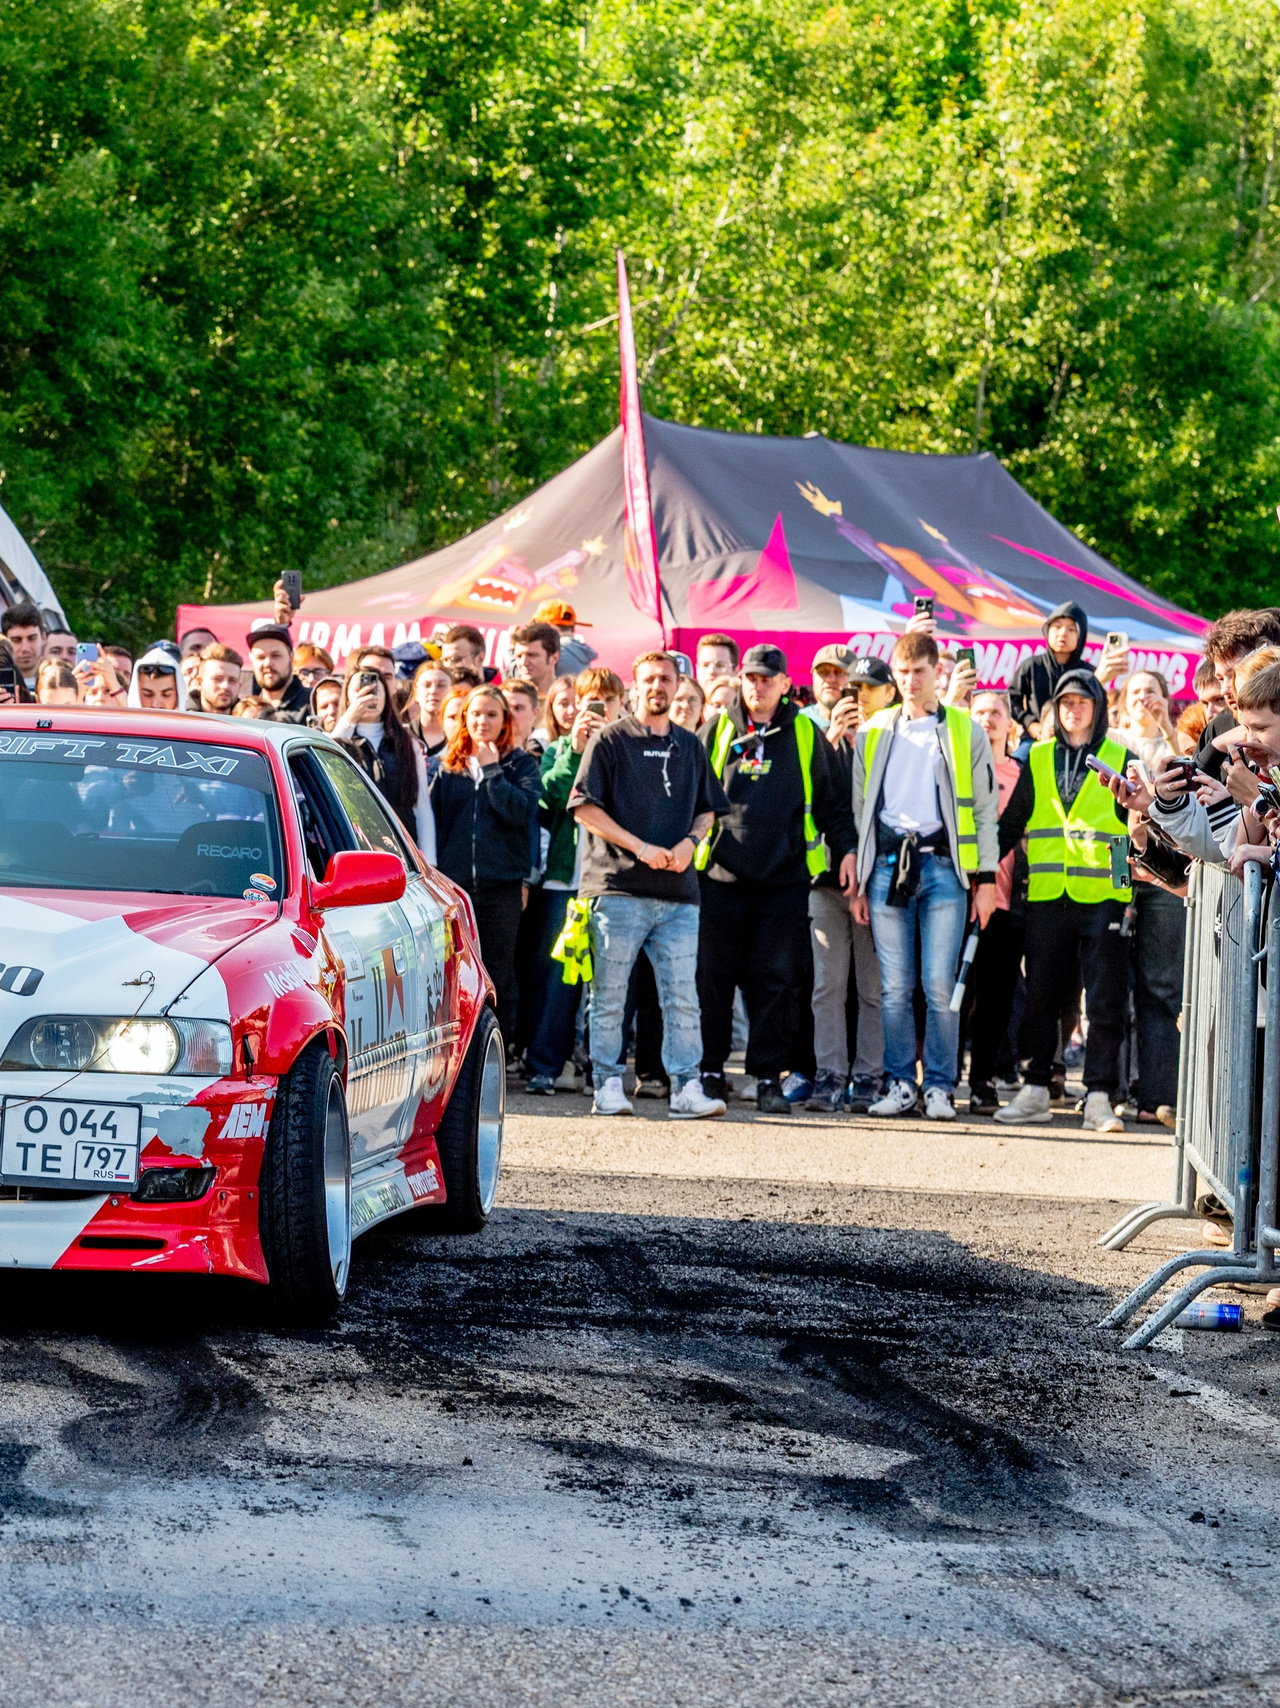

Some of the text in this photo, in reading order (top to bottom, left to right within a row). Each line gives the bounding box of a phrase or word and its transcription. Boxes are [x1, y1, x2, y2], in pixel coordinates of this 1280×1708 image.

[116, 743, 239, 776] TAXI
[197, 843, 262, 861] RECARO
[59, 1107, 117, 1139] 044
[217, 1102, 267, 1139] AEM
[81, 1145, 126, 1170] 797
[93, 1170, 114, 1179] RUS
